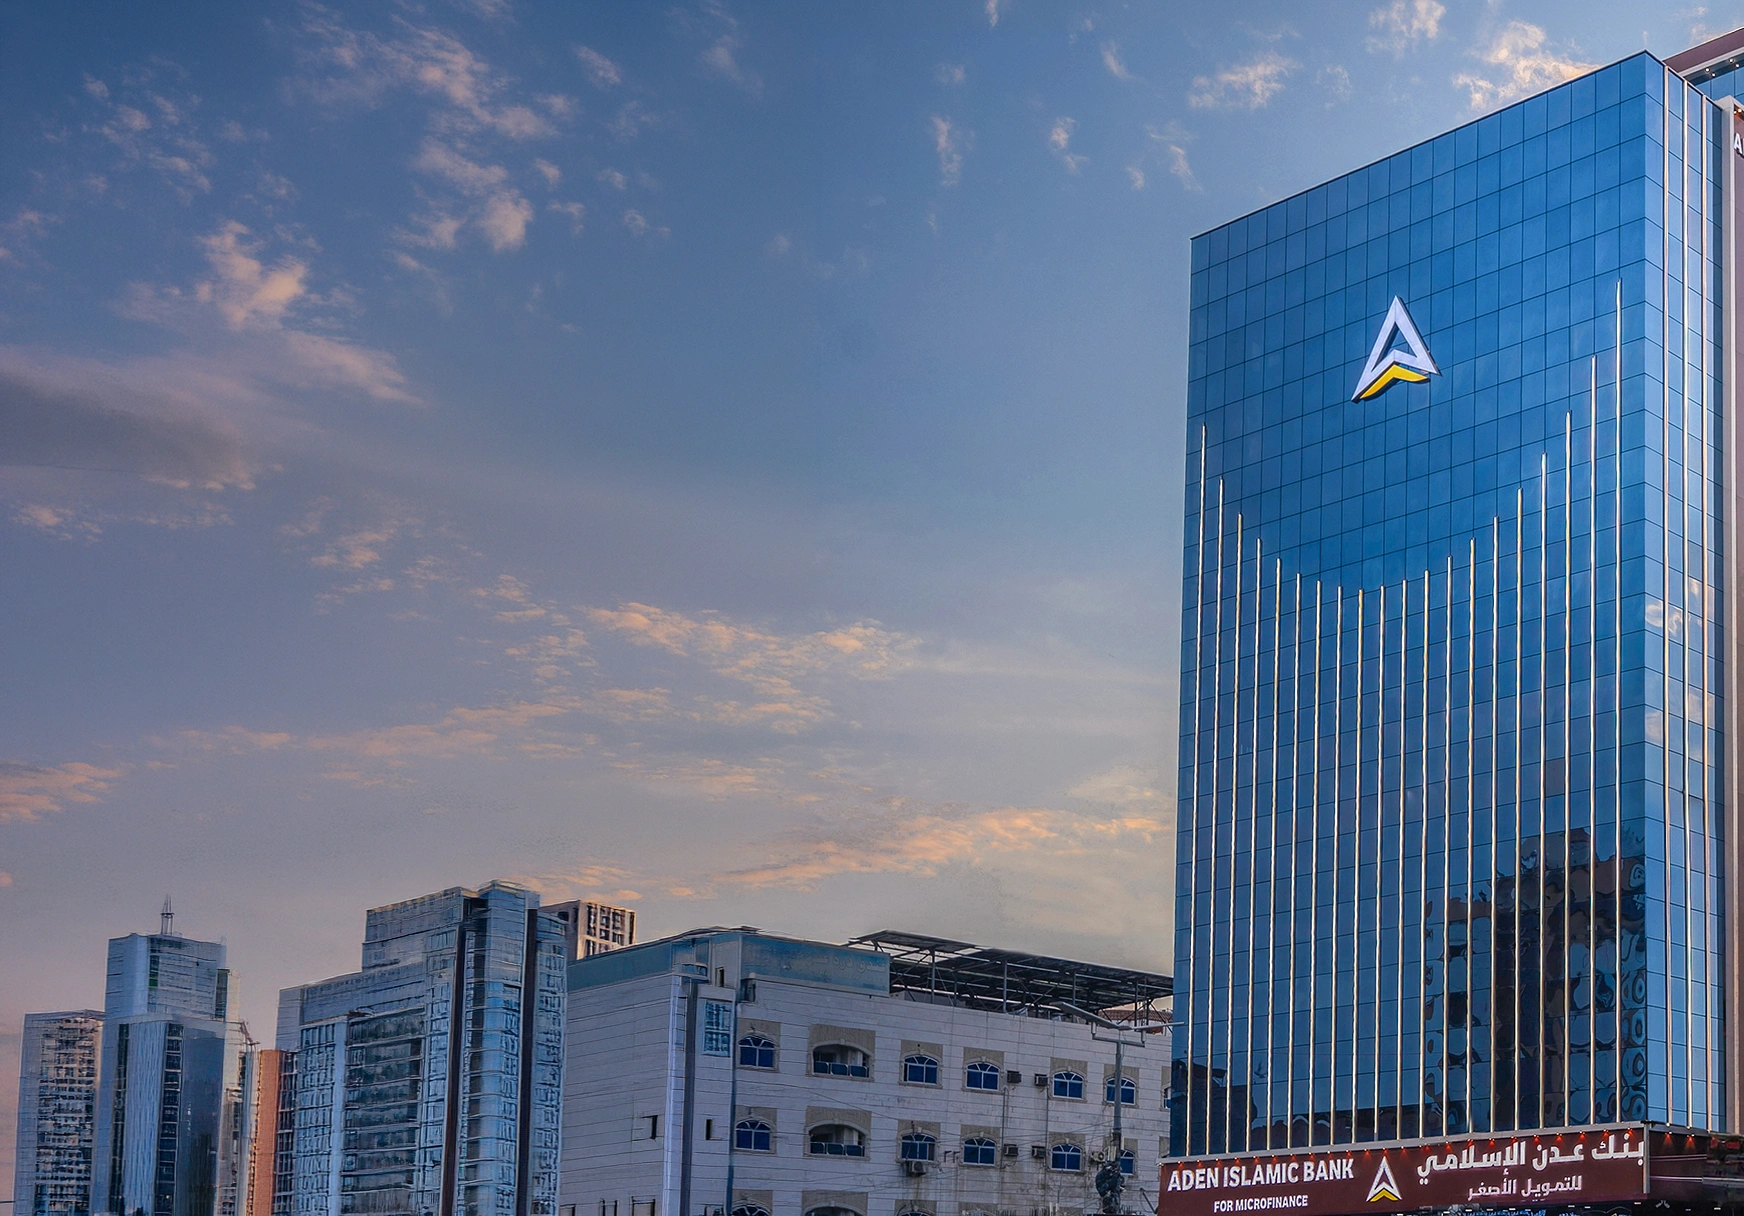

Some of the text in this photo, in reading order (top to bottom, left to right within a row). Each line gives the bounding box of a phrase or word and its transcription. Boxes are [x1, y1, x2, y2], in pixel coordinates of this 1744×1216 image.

[1416, 1132, 1644, 1186] بنك عدن الإسلامي
[1167, 1158, 1354, 1192] ADEN ISLAMIC BANK
[1467, 1175, 1582, 1202] للتمويل الأصغر
[1213, 1194, 1308, 1213] FOR MICROFINANCE
